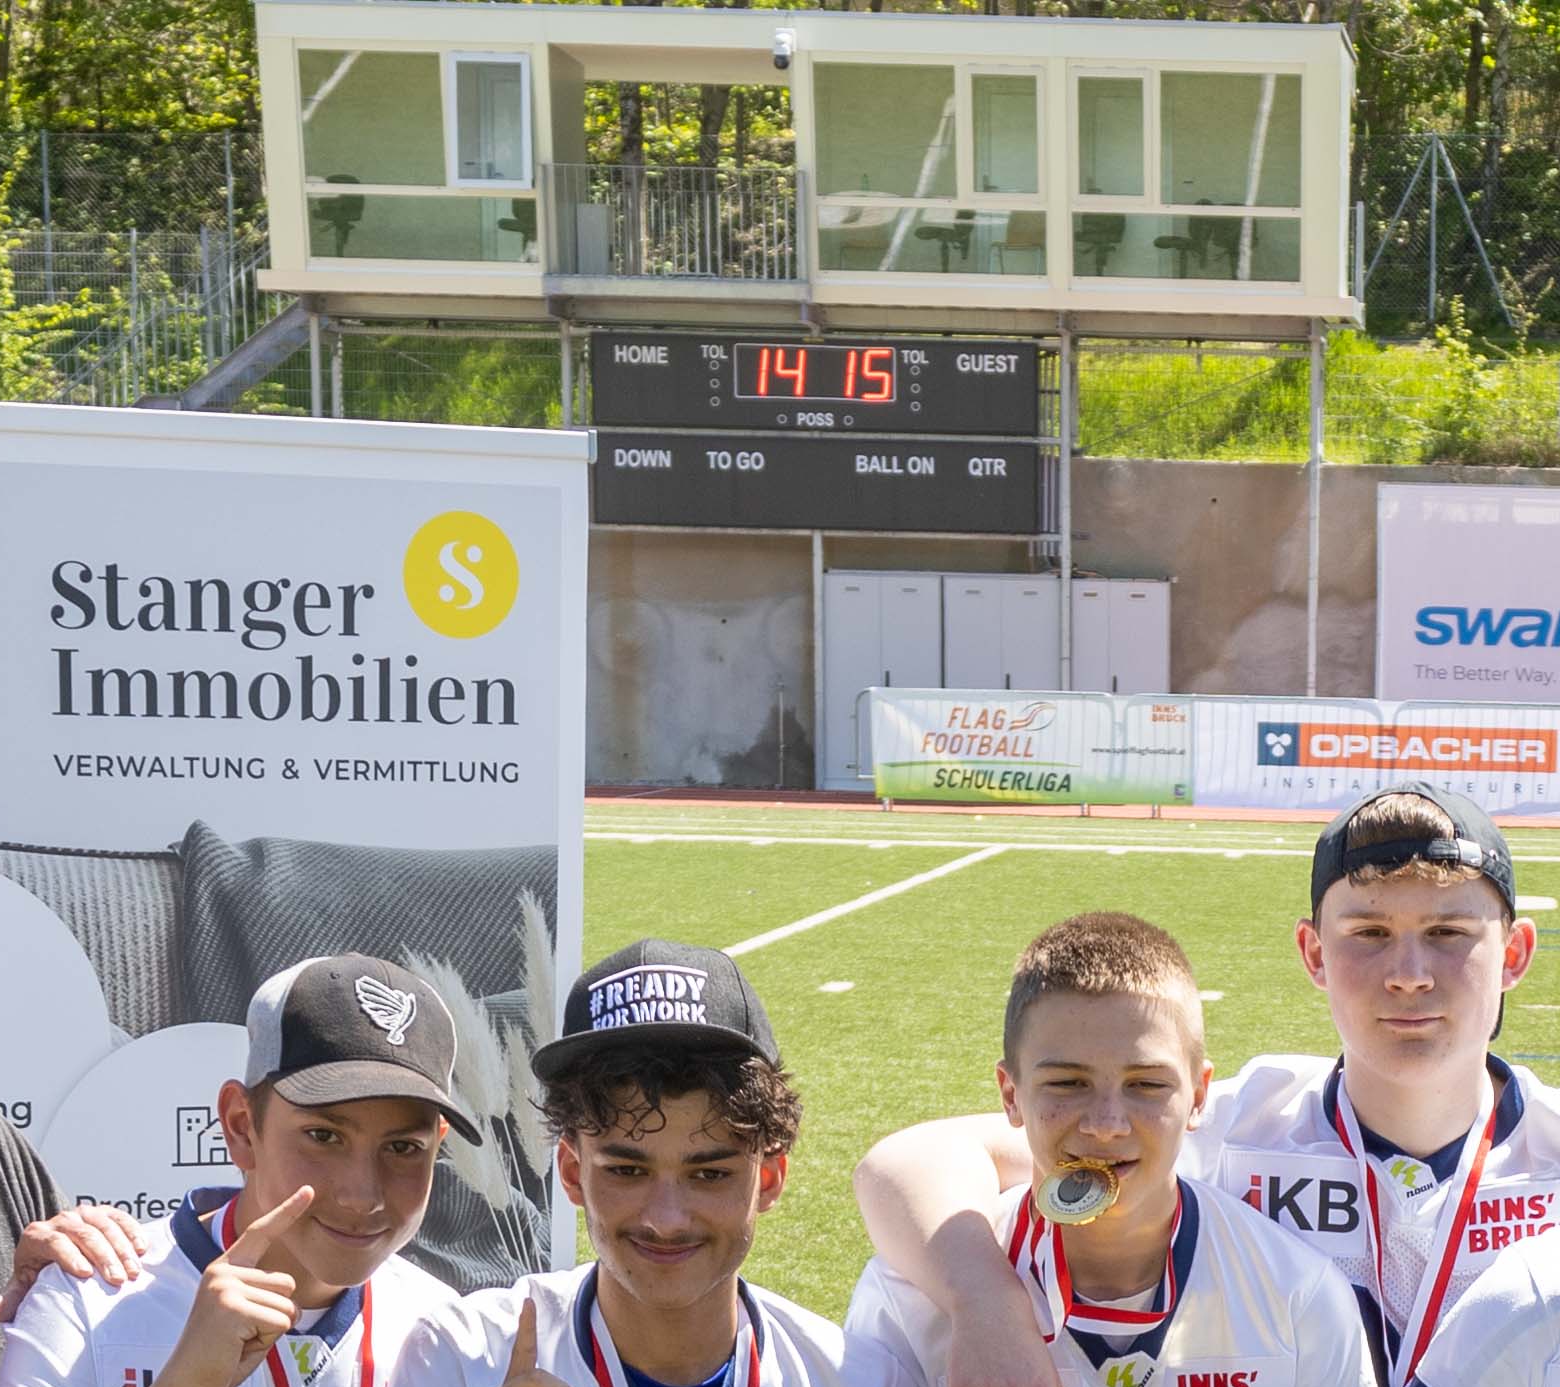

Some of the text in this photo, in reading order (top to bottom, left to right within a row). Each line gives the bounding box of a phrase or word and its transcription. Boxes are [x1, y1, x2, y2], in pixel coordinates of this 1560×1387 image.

[614, 344, 669, 365] HOME
[700, 344, 728, 360] TOL
[901, 348, 929, 365] TOL
[956, 353, 1018, 373] GUEST
[757, 346, 893, 401] 14 15
[796, 411, 834, 427] POSS
[614, 449, 672, 468] DOWN
[706, 450, 765, 471] TO GO
[855, 454, 936, 476] BALL ON
[968, 458, 1007, 477] QTR
[50, 560, 375, 651] Stanger
[1414, 664, 1448, 681] The
[1452, 664, 1509, 683] Better
[1514, 666, 1558, 686] Way.
[50, 647, 519, 727] Immobilien
[947, 706, 1007, 731] FLAG
[922, 732, 1035, 758] FOOTBALL
[1310, 733, 1547, 765] OPBACHER
[53, 754, 520, 785] VERWALTUNG & VERMITTLUNG
[934, 767, 1072, 794] SCHÜLERLIGA
[589, 971, 706, 1019] #READY
[592, 999, 708, 1031] FOR WORK
